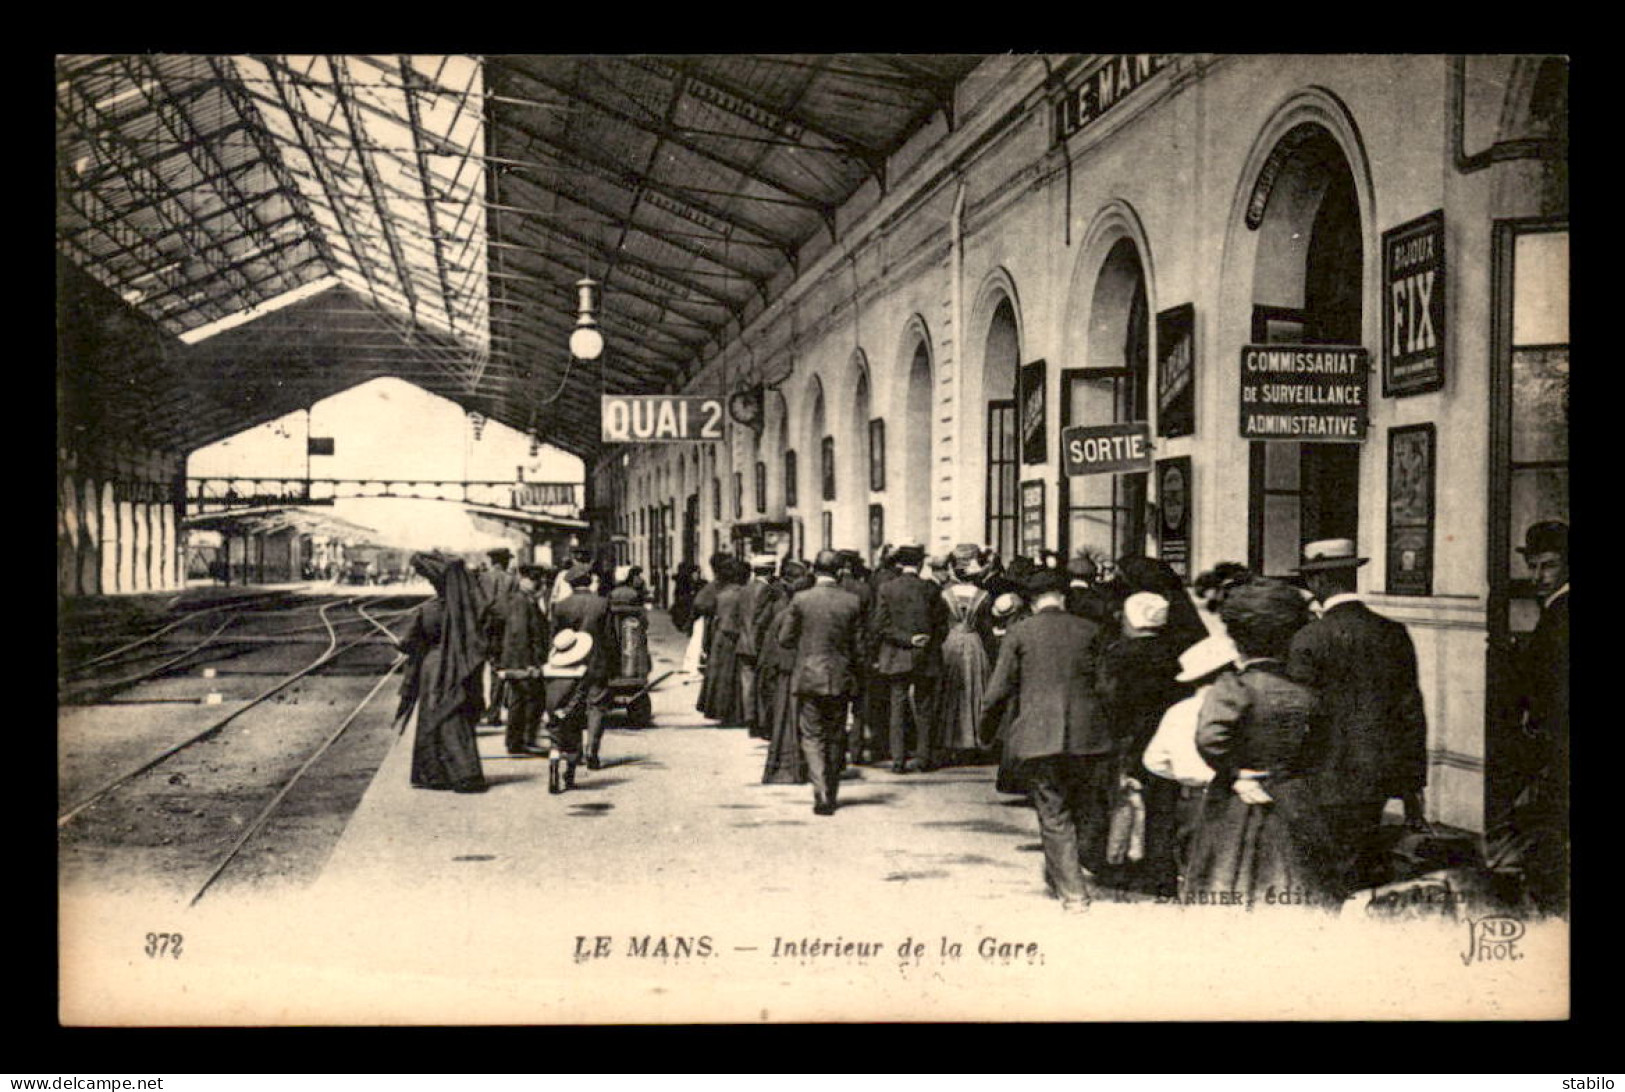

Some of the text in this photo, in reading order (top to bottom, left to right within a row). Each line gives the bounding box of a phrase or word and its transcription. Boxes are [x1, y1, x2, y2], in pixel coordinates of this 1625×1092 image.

[1063, 82, 1090, 135] LE
[1392, 271, 1437, 357] FIX
[1247, 351, 1358, 374] COMMISSARIAT
[1243, 383, 1361, 405] DE SURVEILLANCE
[607, 399, 723, 439] QUAI 2
[1247, 415, 1358, 435] ADMINISTRATIVE
[1069, 433, 1146, 464] SORTIE
[522, 485, 562, 505] QUAI
[145, 932, 183, 959] 372
[573, 935, 1045, 961] LE MANS. Intérieur de la Gare.
